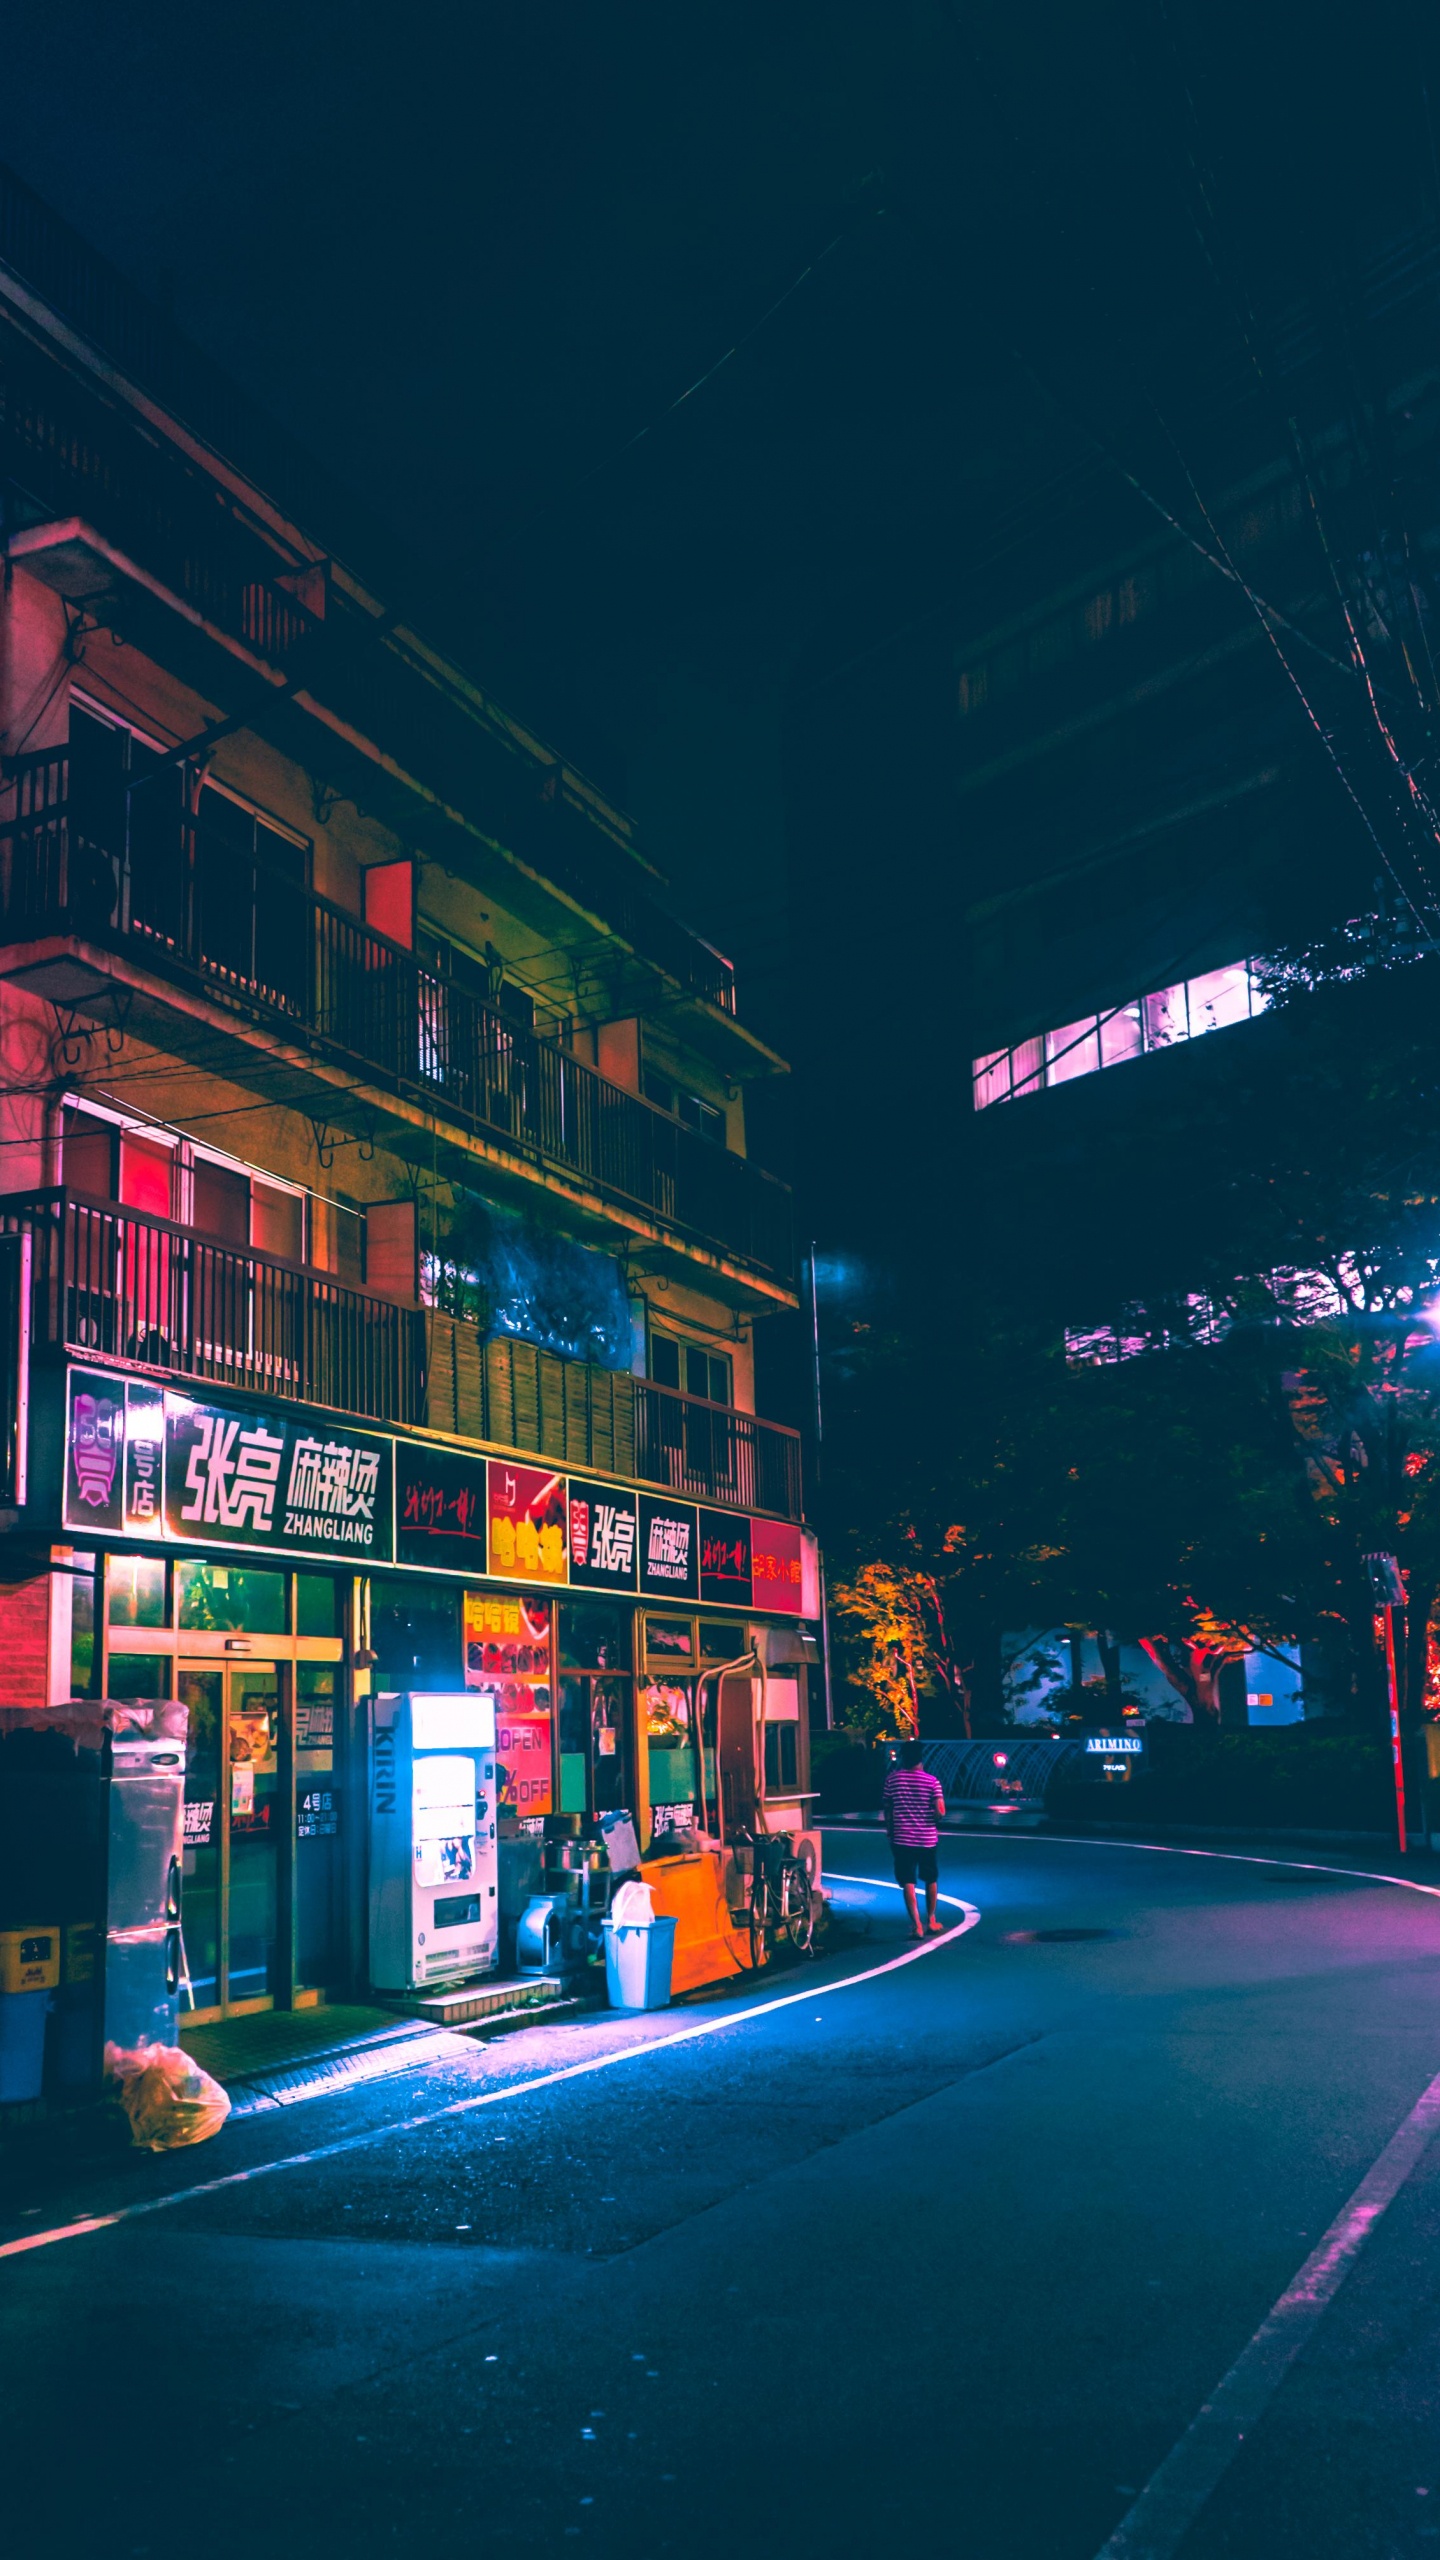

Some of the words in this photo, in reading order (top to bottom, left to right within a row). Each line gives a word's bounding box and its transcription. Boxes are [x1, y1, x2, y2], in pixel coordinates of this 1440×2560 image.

[181, 1415, 284, 1532] 张亮
[283, 1513, 373, 1545] ZHANGLIANG
[591, 1504, 636, 1573] 张亮
[647, 1562, 688, 1581] ZHANGLIANG
[1087, 1738, 1141, 1750] ARIMINO
[375, 1719, 398, 1814] KIRIN
[303, 1792, 332, 1812] 4号店
